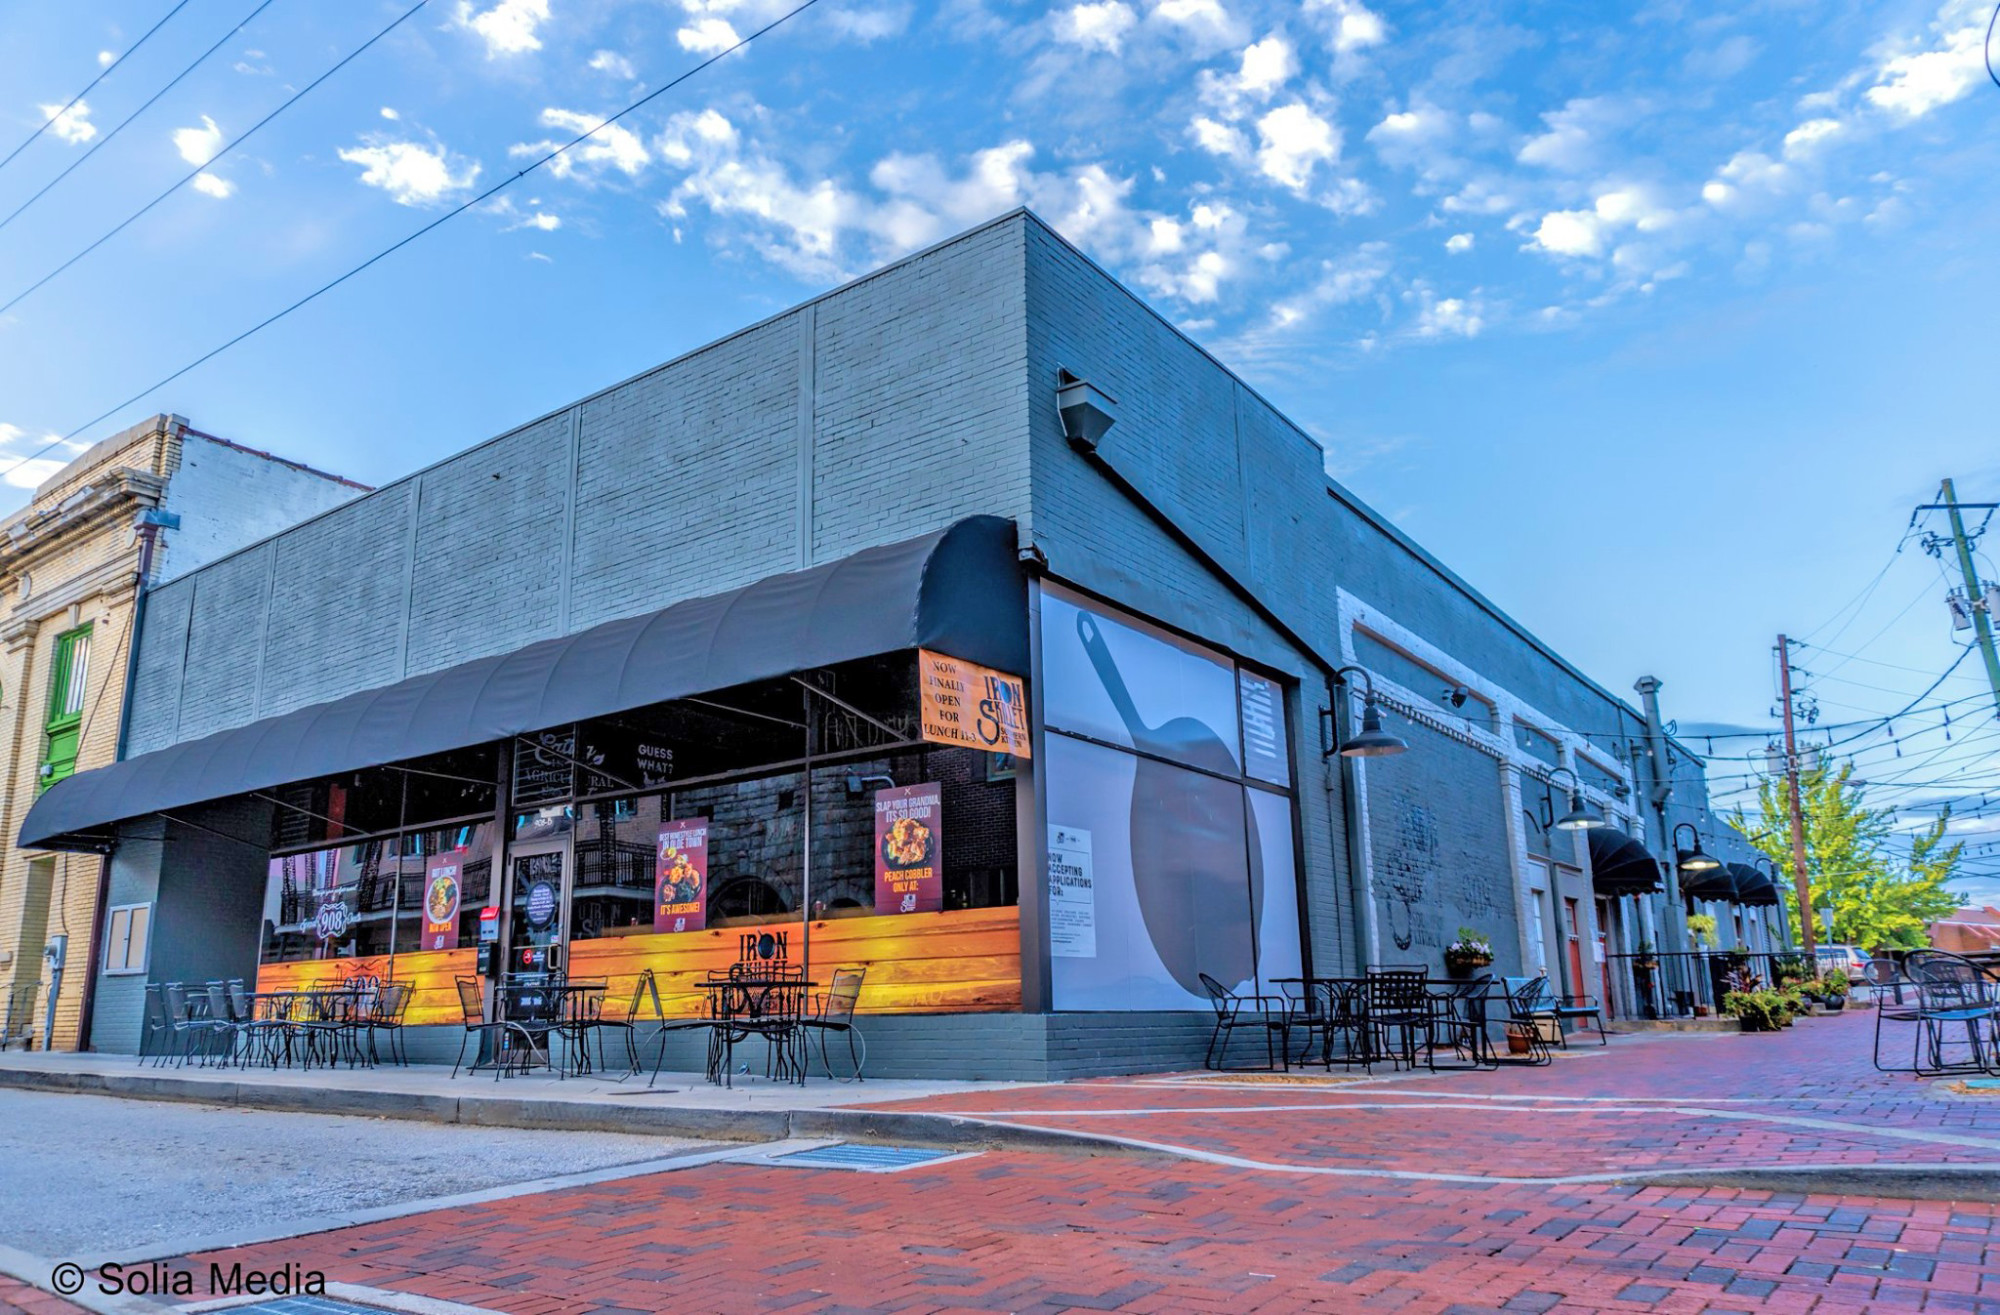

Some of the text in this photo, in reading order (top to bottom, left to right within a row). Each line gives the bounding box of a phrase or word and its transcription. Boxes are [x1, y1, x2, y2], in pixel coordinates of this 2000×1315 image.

[932, 661, 956, 674] NOW
[929, 676, 964, 692] FINALLY
[984, 675, 1022, 707] IRON
[935, 693, 960, 707] OPEN
[940, 710, 959, 722] FOR
[977, 699, 1024, 746] SKILLET
[924, 724, 976, 742] LUNCH 11-3
[638, 744, 673, 760] GUESS
[637, 758, 674, 774] WHAT?
[876, 800, 891, 812] SLAP
[892, 798, 908, 810] YOUR
[899, 809, 908, 819] SO
[910, 806, 931, 819] GOOD!
[884, 867, 933, 882] PEACH COBBLER
[893, 880, 908, 893] ONLY
[321, 910, 343, 932] 908
[739, 930, 788, 961] IRON
